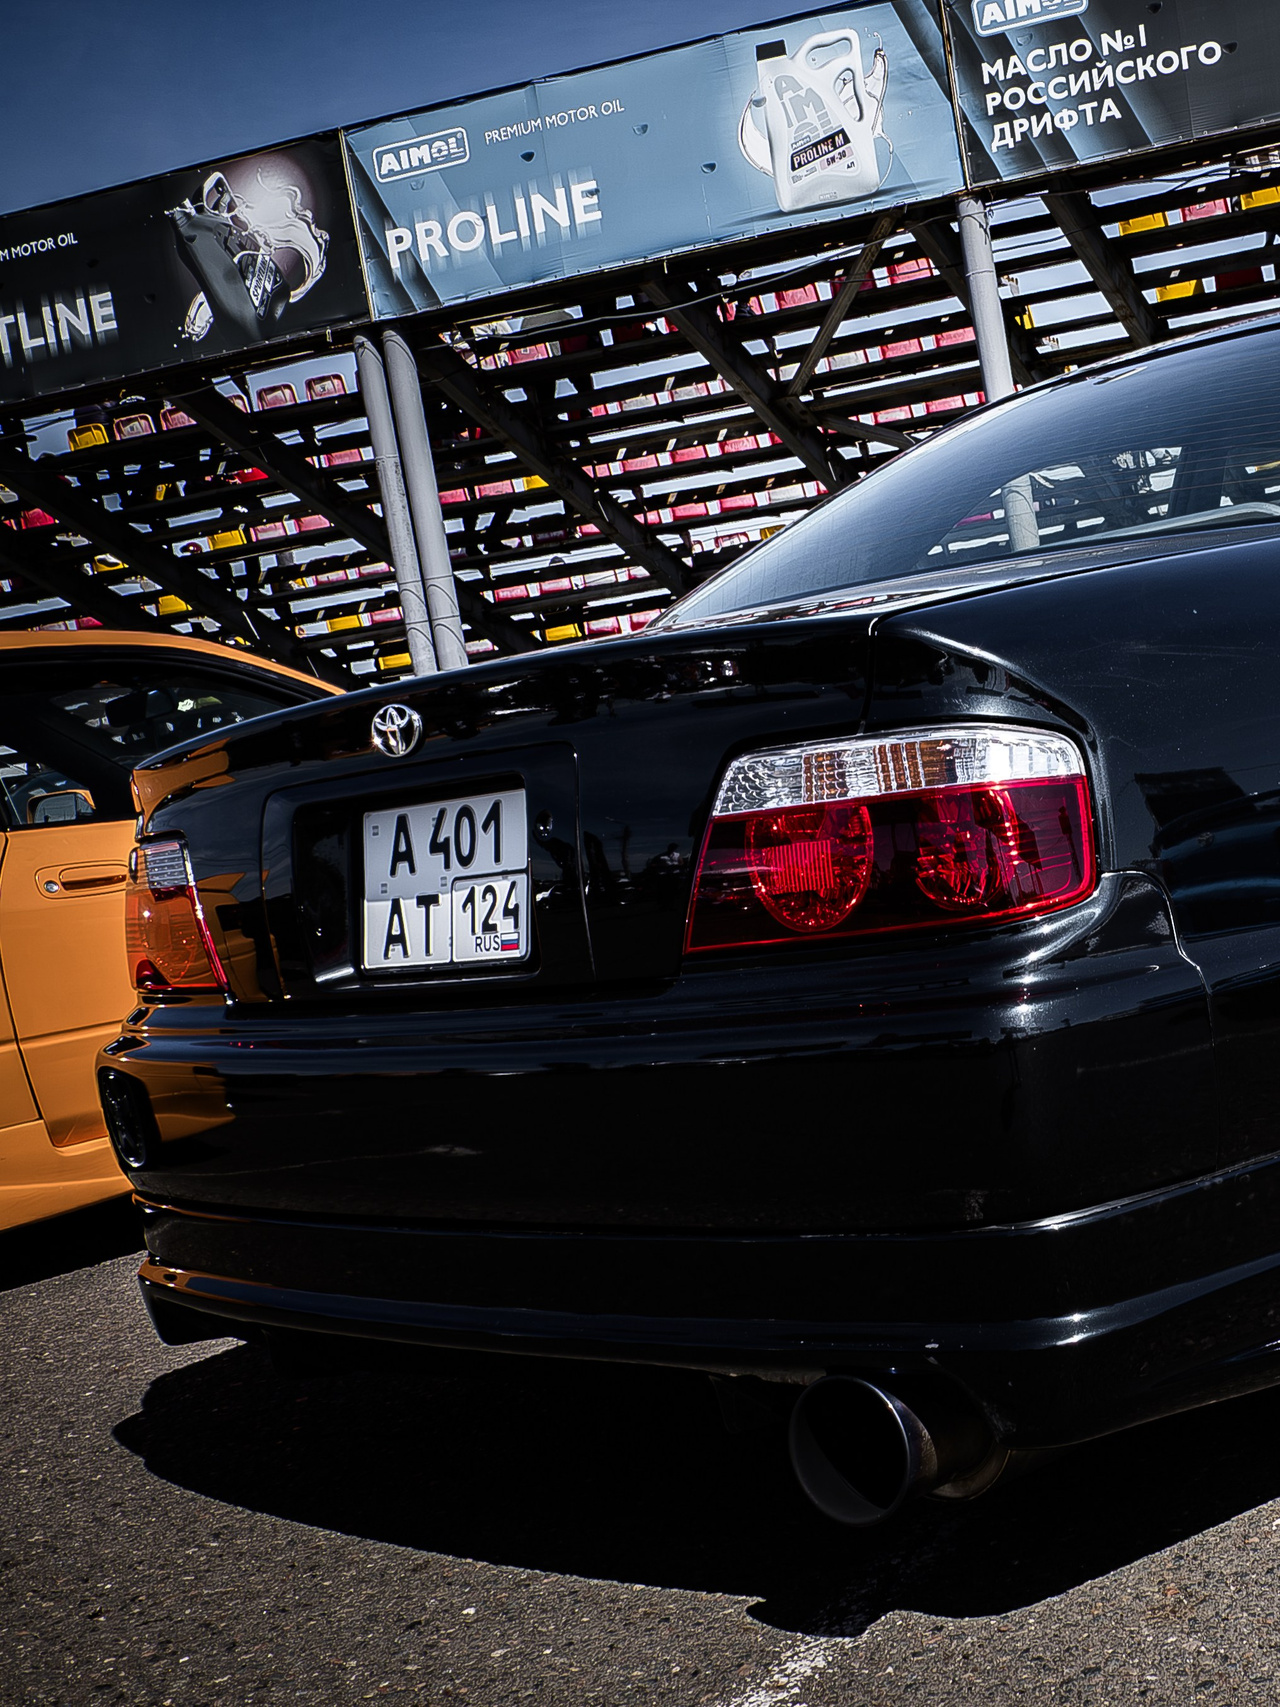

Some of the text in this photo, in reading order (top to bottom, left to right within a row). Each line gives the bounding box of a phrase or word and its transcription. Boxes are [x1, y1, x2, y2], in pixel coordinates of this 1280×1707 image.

[981, 0, 1082, 27] AIM
[981, 38, 1093, 85] МАСЛО
[985, 41, 1222, 116] РОССИЙСКОГО
[485, 98, 626, 146] PREMIUM MOTOR OIL
[991, 97, 1122, 153] ДРИФТА
[793, 138, 834, 169] PROLINE
[834, 133, 845, 148] M
[11, 237, 56, 259] MOTOR
[57, 232, 78, 248] OIL
[385, 180, 602, 270] PROLINE
[462, 880, 520, 937] 124
[475, 934, 501, 953] RUS
